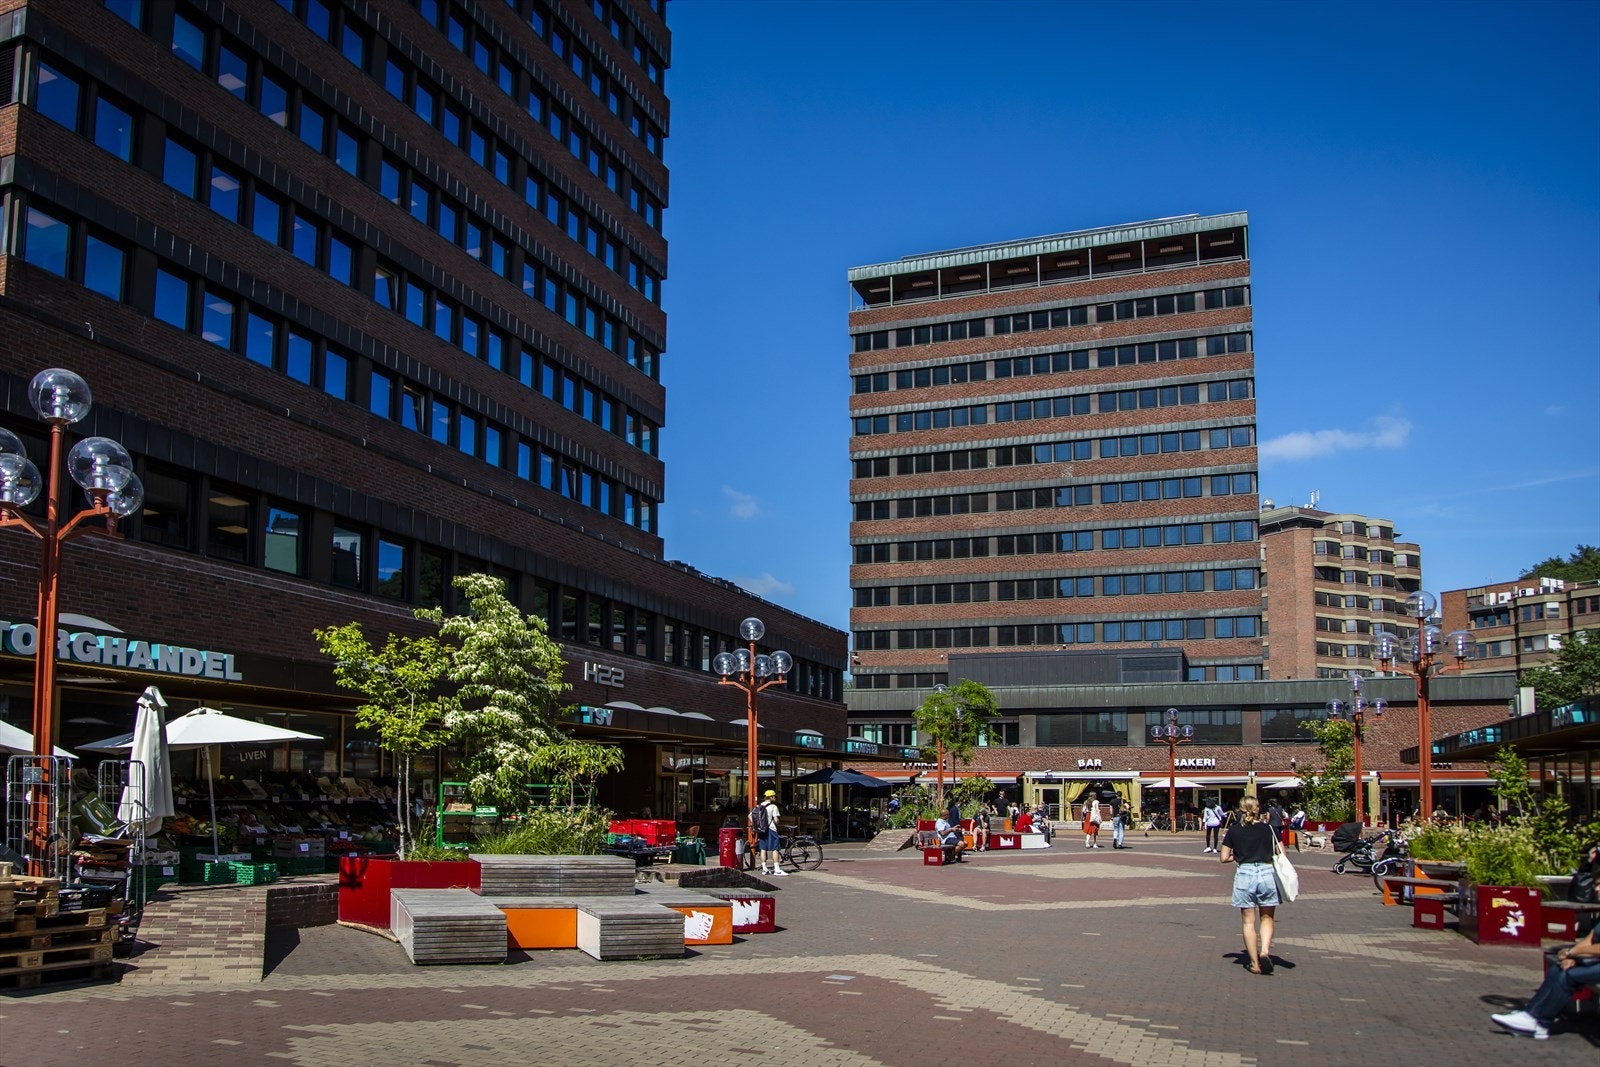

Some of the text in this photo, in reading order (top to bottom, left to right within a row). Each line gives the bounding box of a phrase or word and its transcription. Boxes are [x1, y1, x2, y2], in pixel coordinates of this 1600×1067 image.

[584, 661, 625, 688] H22
[1077, 759, 1102, 767] BAR
[1174, 758, 1216, 767] BAKERI
